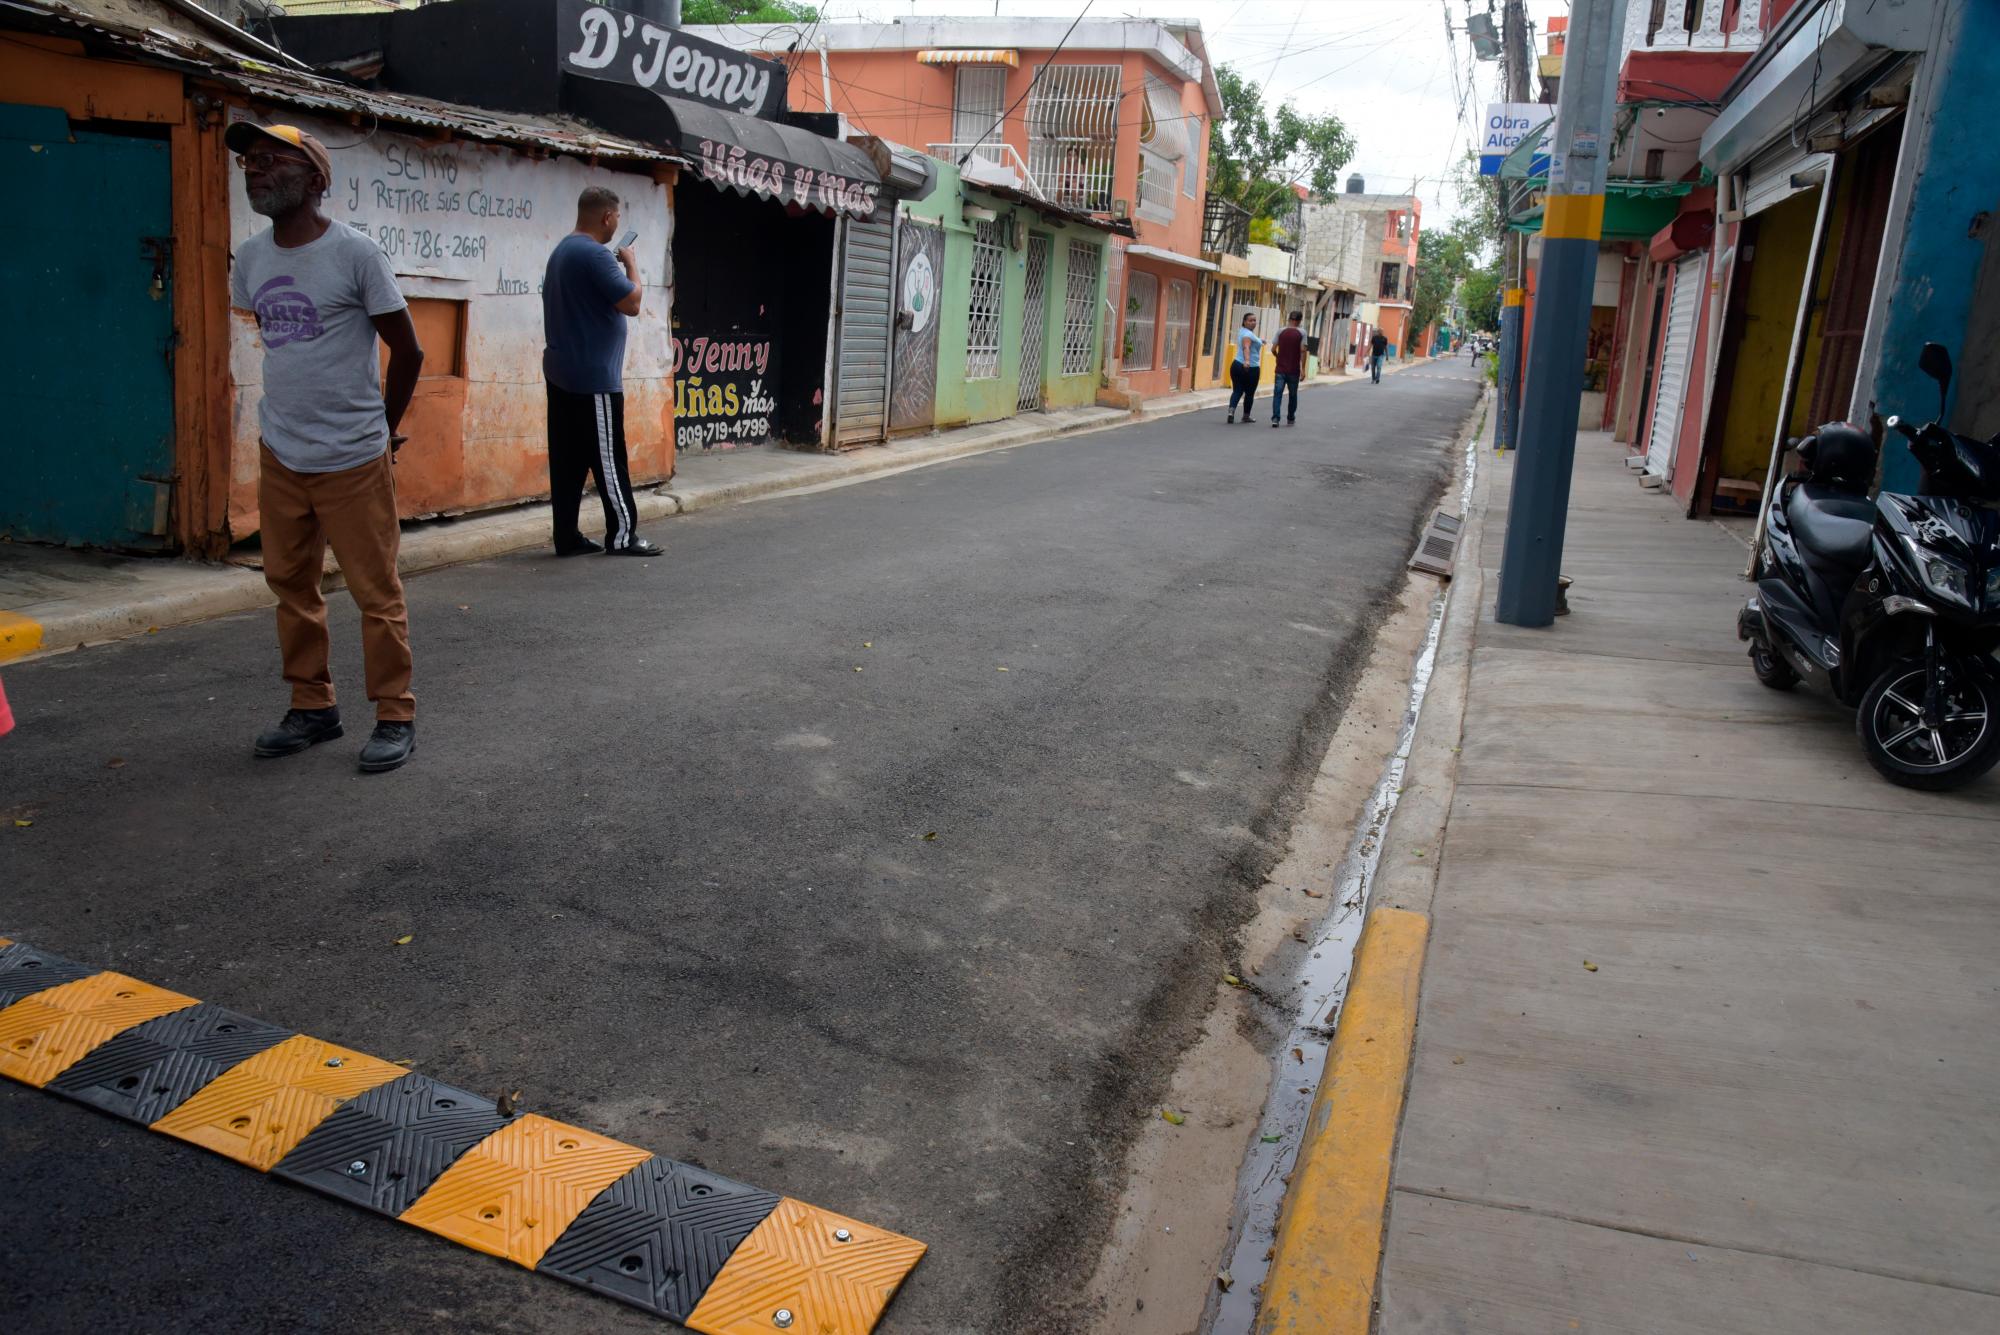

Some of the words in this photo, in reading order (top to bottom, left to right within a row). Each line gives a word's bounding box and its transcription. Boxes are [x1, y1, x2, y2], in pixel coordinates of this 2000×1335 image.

[569, 7, 770, 116] D'Jenny
[1490, 115, 1530, 129] Obra
[700, 140, 785, 195] Uñas
[794, 165, 813, 205] y
[817, 169, 875, 214] más
[257, 302, 319, 323] ARTS
[263, 320, 325, 336] ROGRAM
[671, 337, 770, 375] D'Jenny
[750, 379, 762, 398] y
